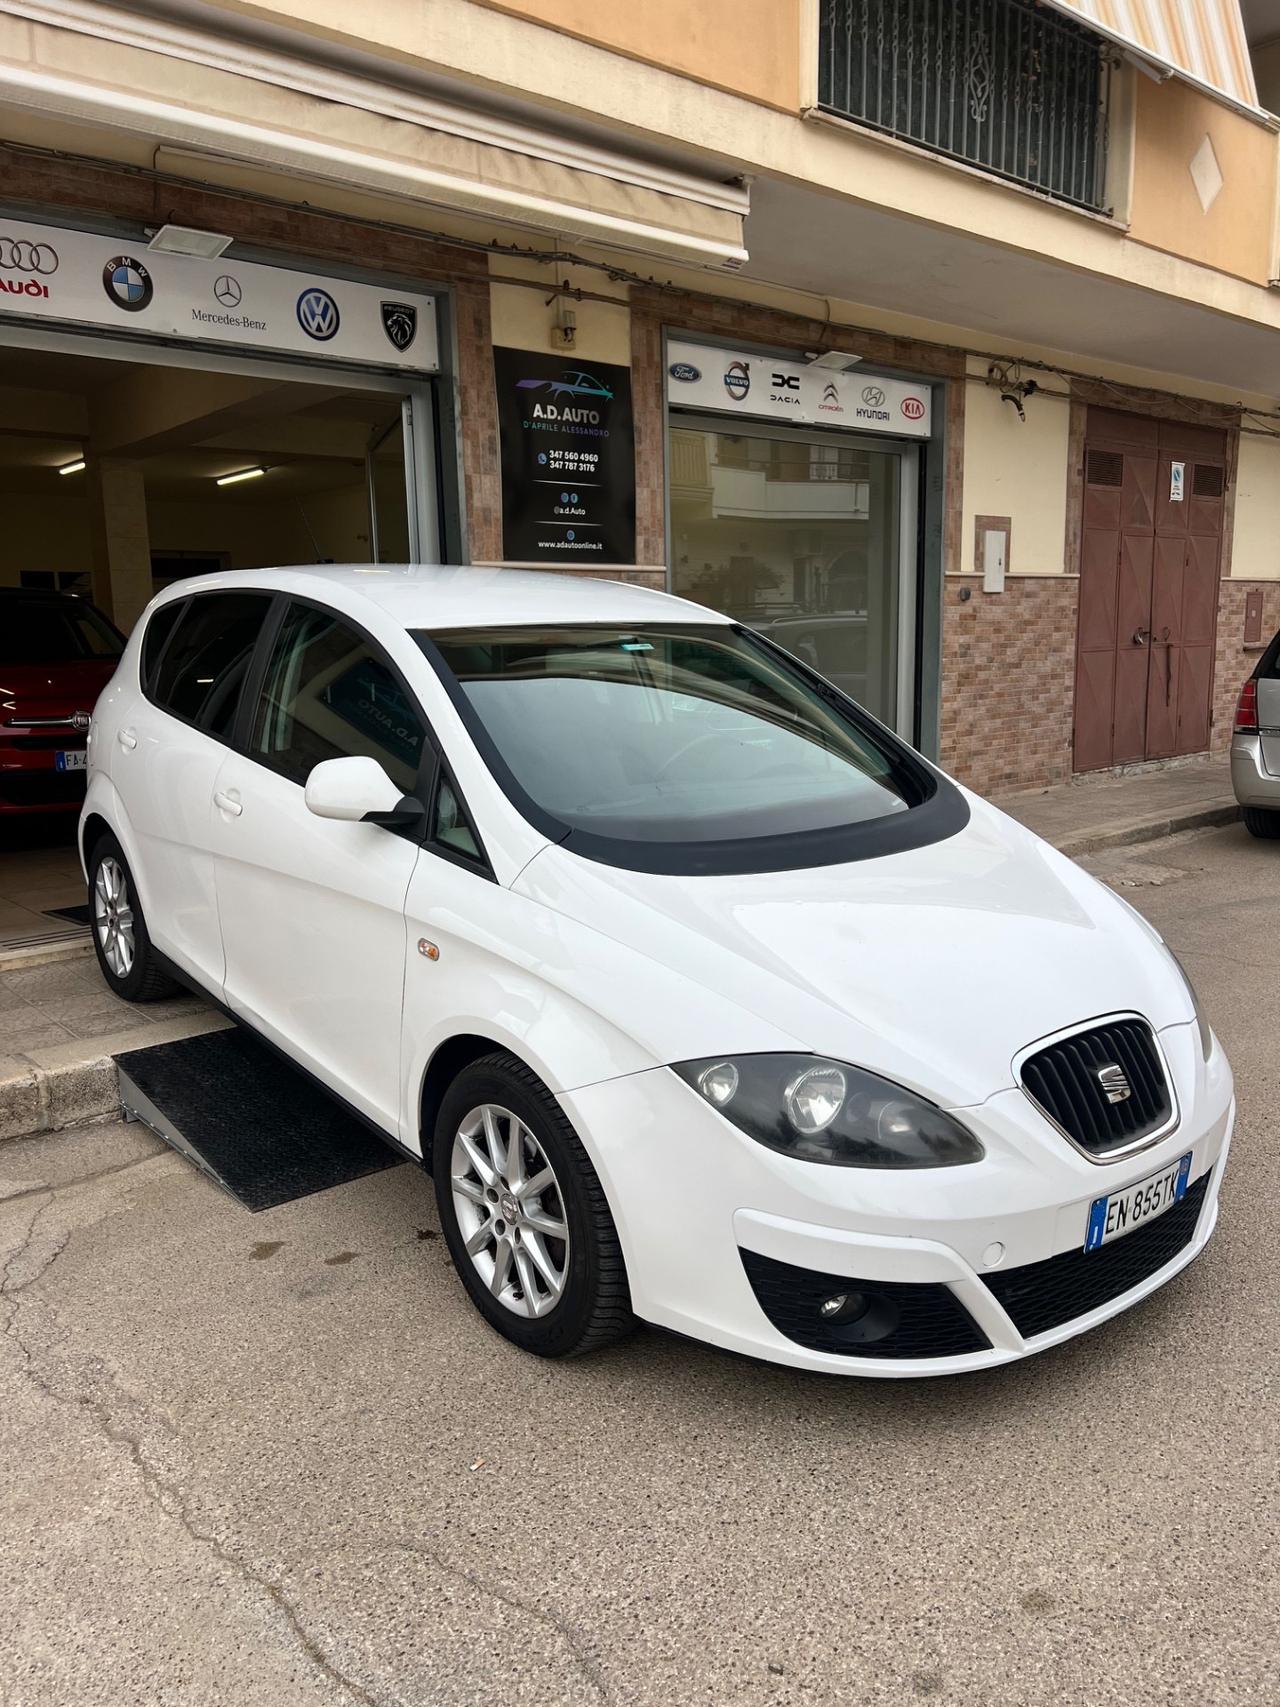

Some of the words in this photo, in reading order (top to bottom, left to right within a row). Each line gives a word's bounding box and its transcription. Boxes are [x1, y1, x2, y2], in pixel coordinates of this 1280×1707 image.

[107, 257, 147, 277] BMW
[192, 308, 267, 331] Mercedes-Benz
[726, 376, 749, 386] VOLVO
[770, 394, 801, 405] DACIA
[856, 408, 890, 421] HYUNDAI
[904, 402, 921, 416] KIA
[561, 425, 610, 438] ALESSANDRO
[549, 450, 563, 459] 347
[564, 451, 579, 461] 560
[580, 453, 599, 463] 4960
[549, 460, 563, 470] 347
[564, 462, 578, 471] 787
[578, 463, 596, 473] 3176
[537, 541, 603, 550] www.adautoonline.it
[1105, 1195, 1130, 1235] EN
[1132, 1170, 1179, 1221] 855TK
